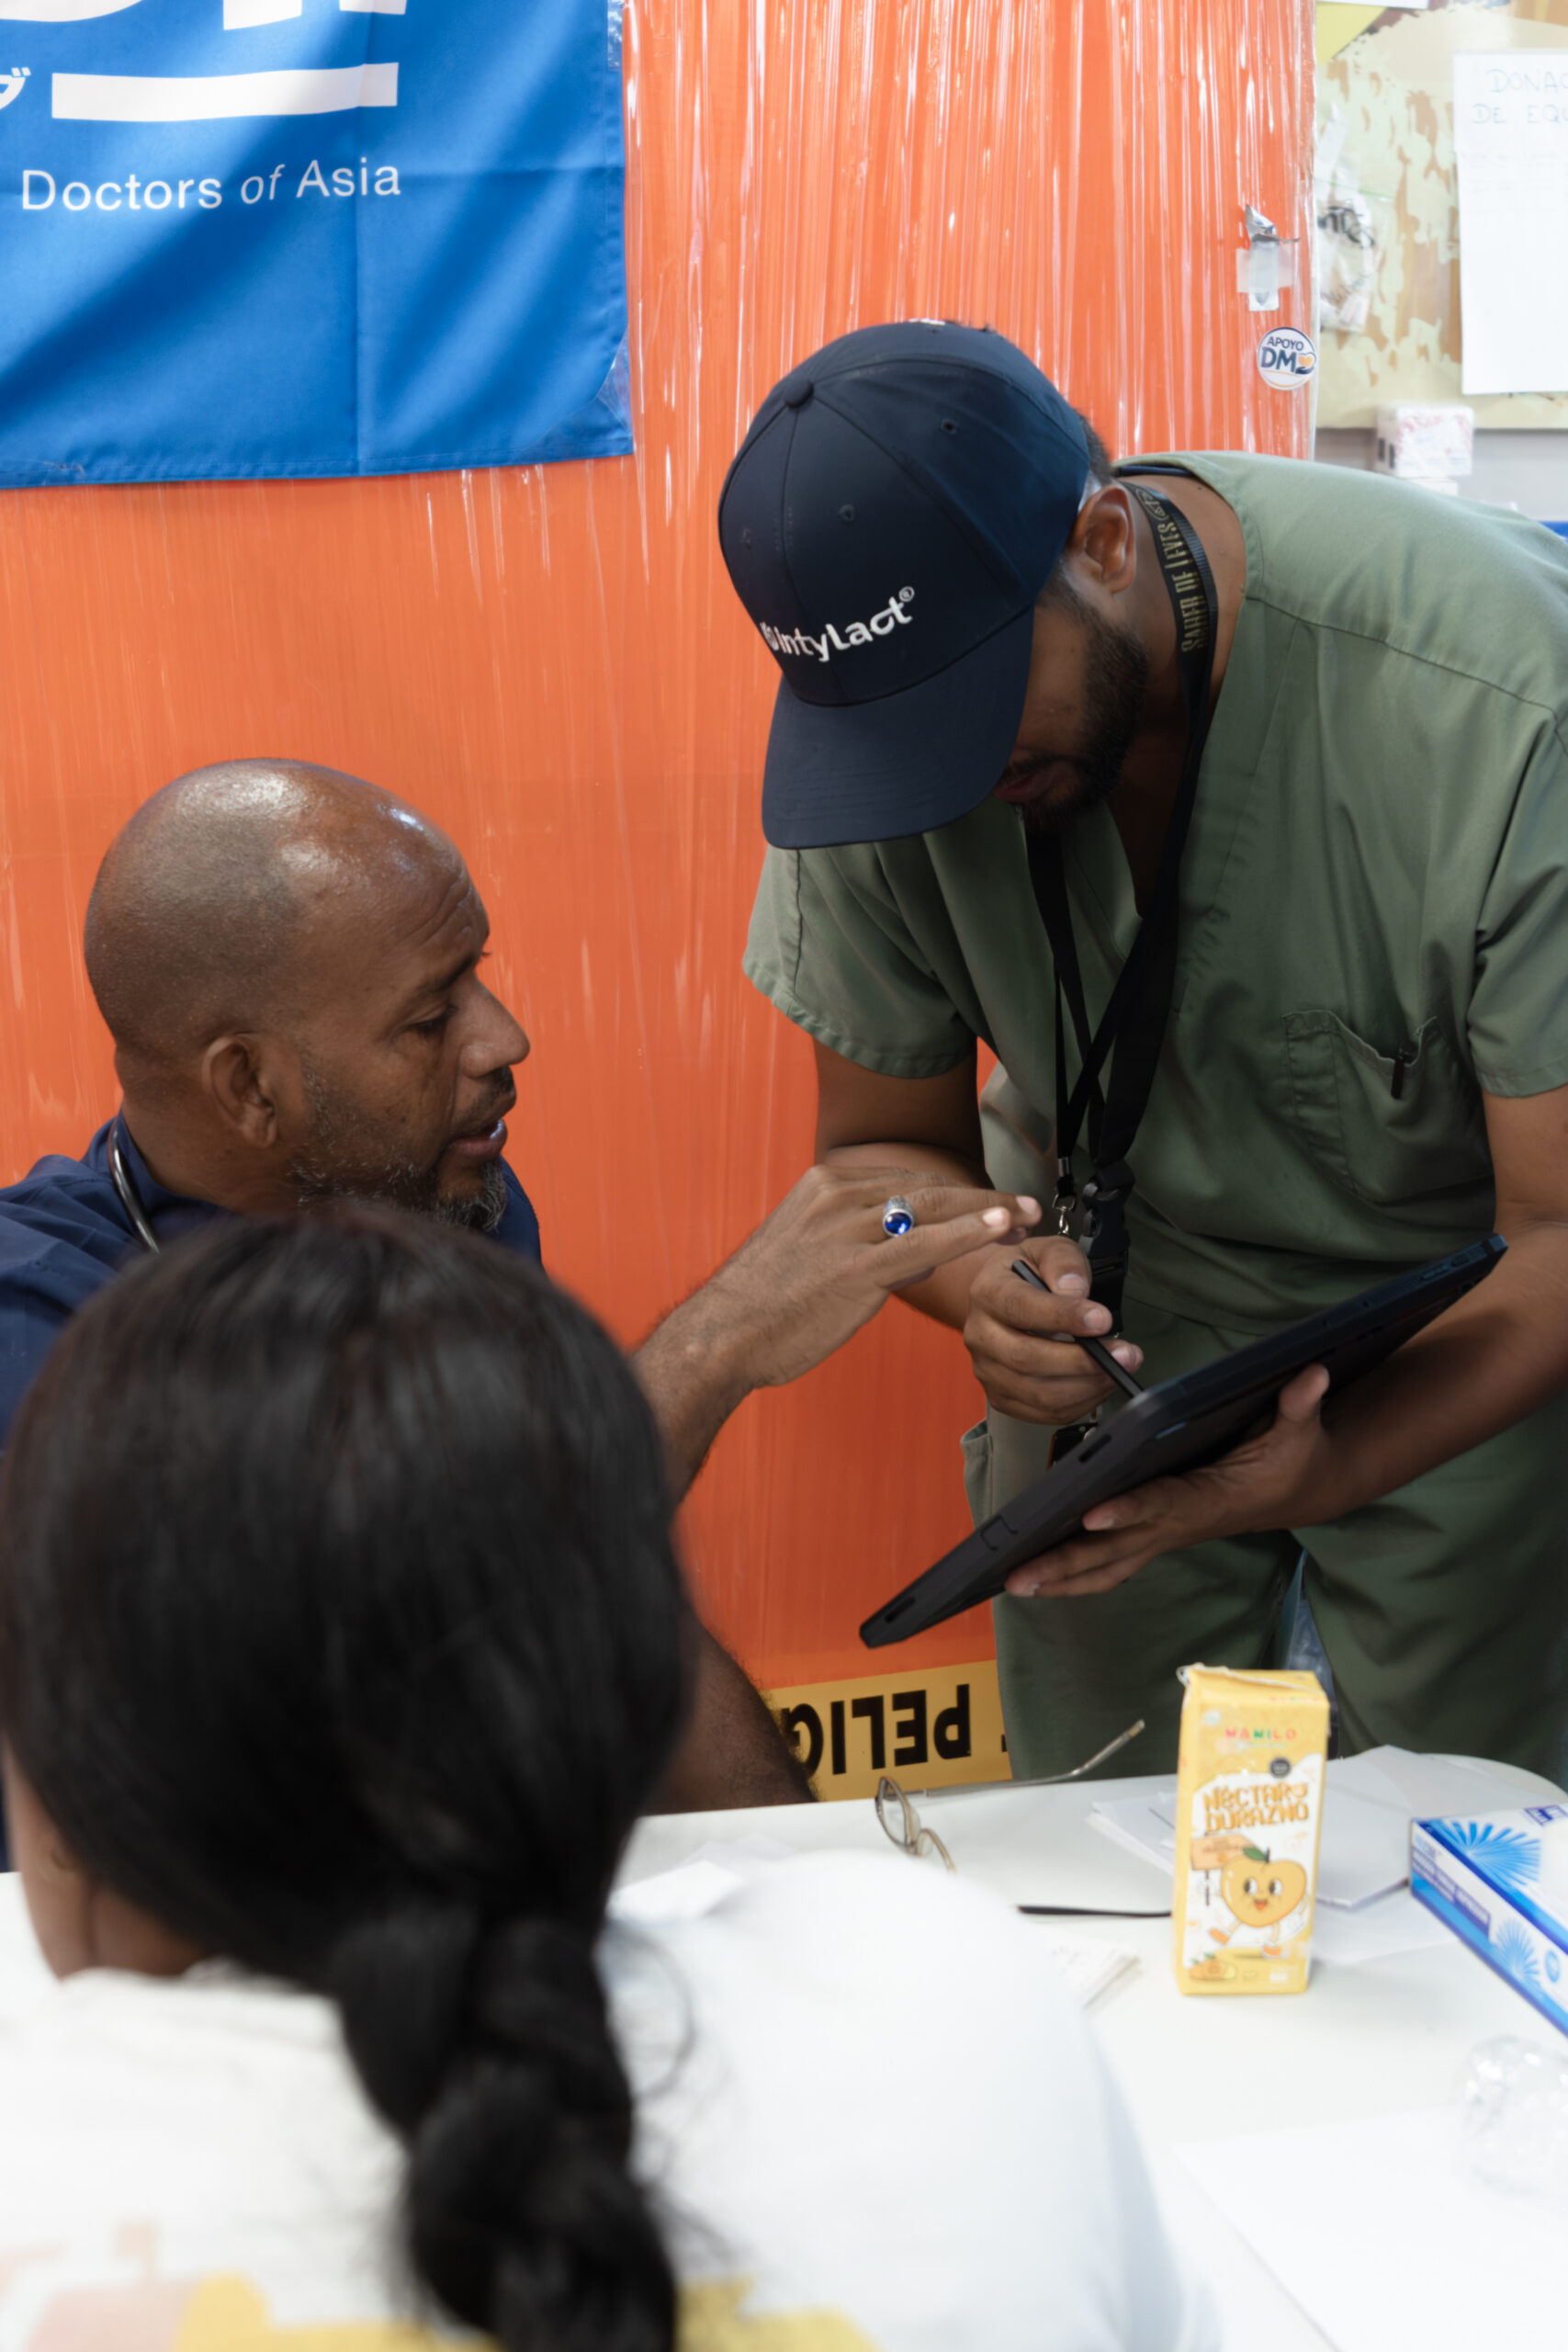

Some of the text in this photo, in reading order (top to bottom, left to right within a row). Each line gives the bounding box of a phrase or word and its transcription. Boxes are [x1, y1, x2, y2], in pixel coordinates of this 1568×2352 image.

[1472, 103, 1506, 125] DE
[21, 157, 401, 212] Doctors of Asia
[1267, 336, 1304, 352] APOYO
